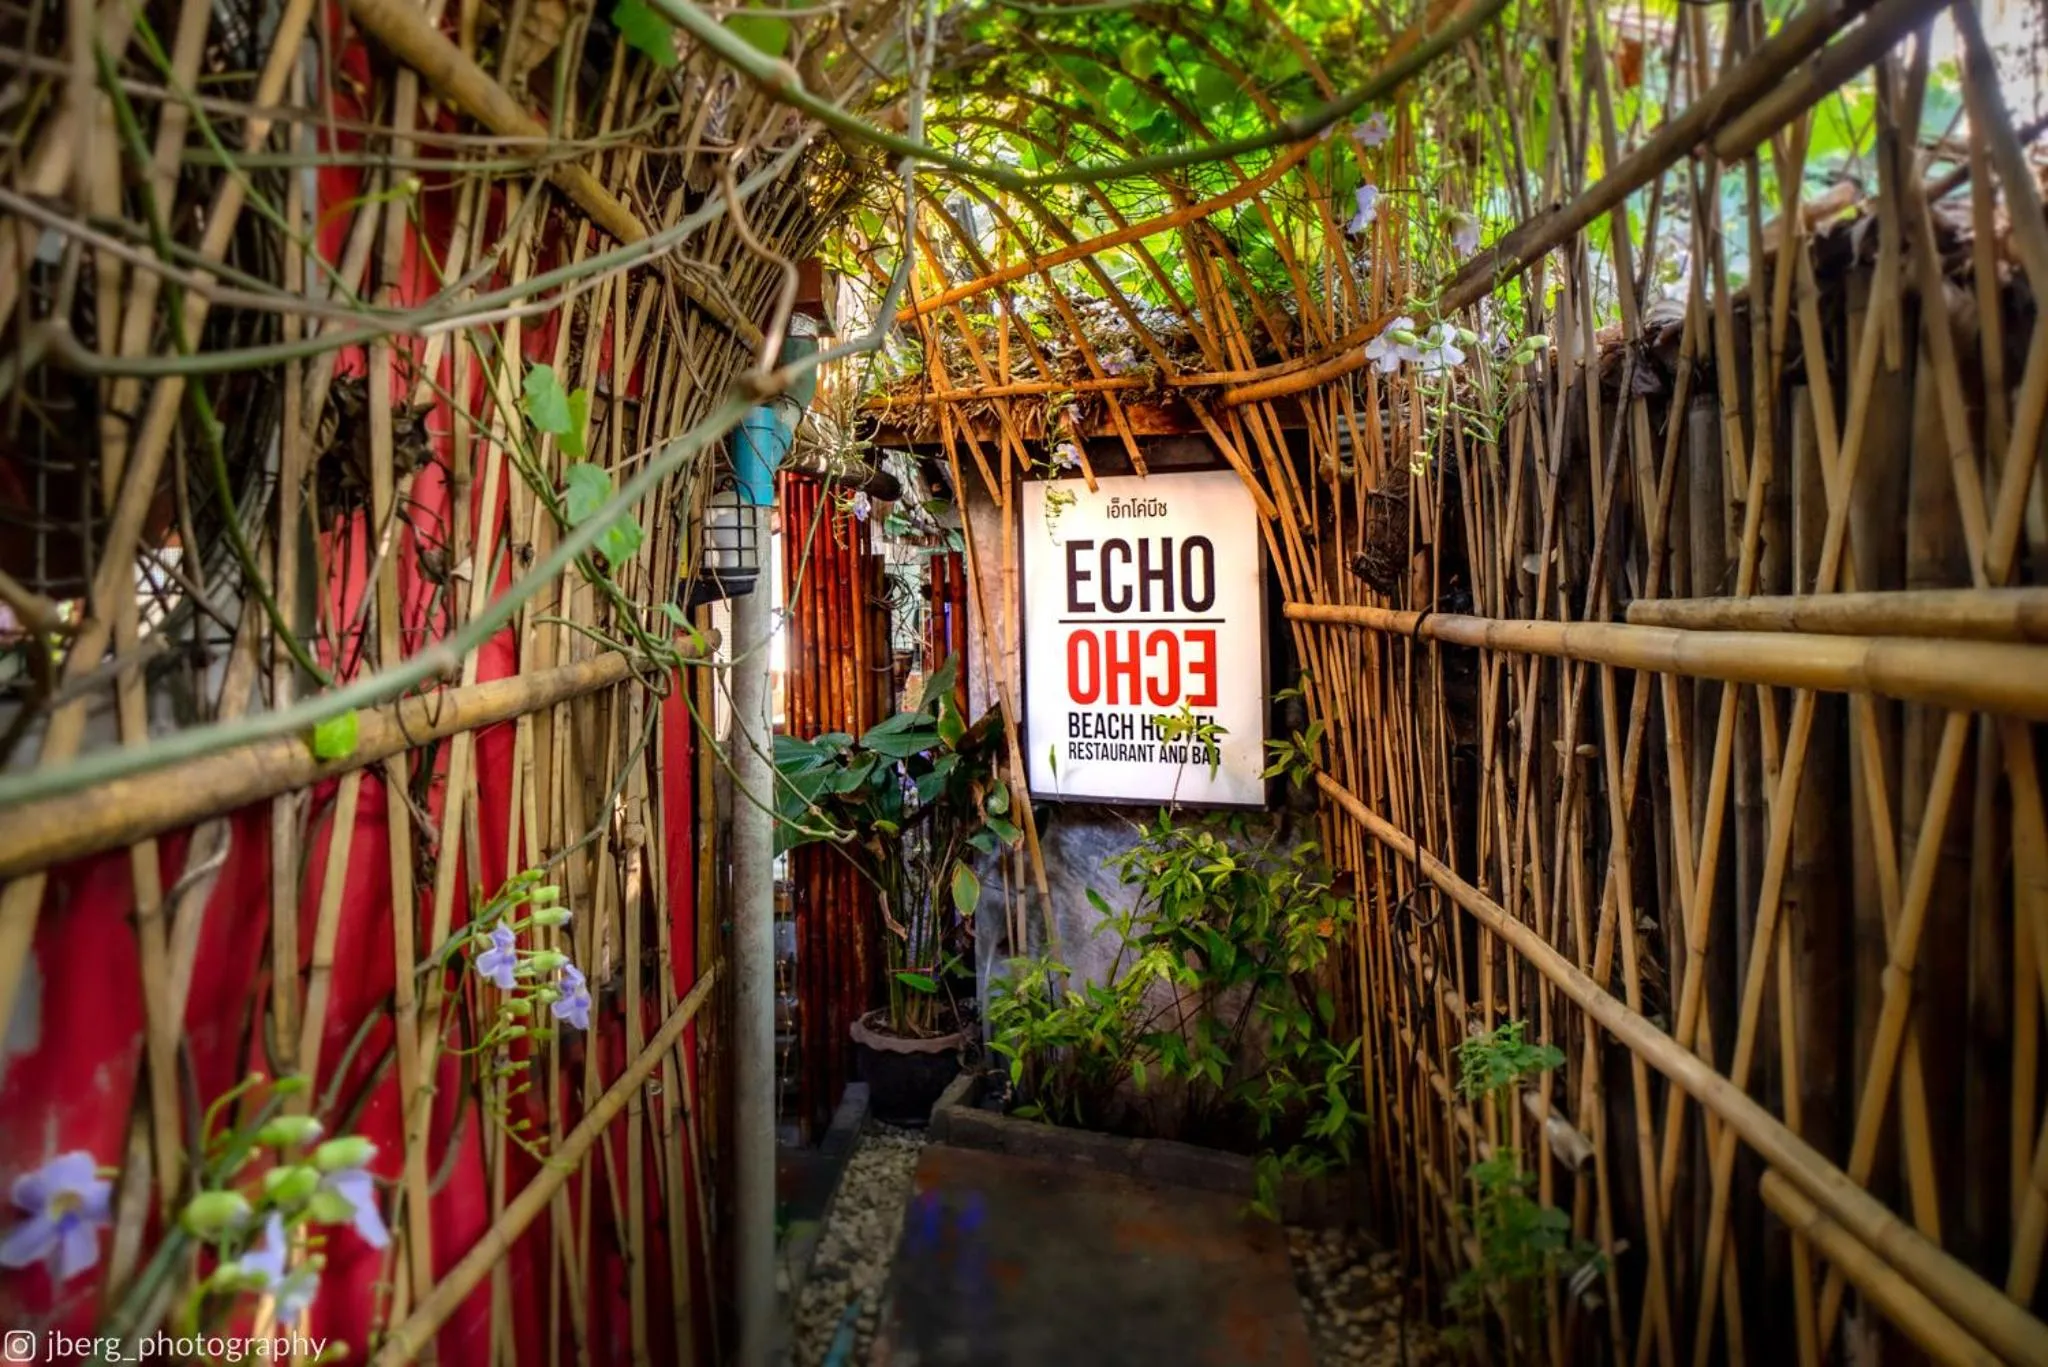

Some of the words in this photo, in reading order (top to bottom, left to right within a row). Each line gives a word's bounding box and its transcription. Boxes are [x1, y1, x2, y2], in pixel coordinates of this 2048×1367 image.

[1066, 535, 1216, 613] ECHO
[1068, 712, 1133, 740] BEACH
[1068, 741, 1155, 763] RESTAURANT
[1159, 745, 1188, 764] AND
